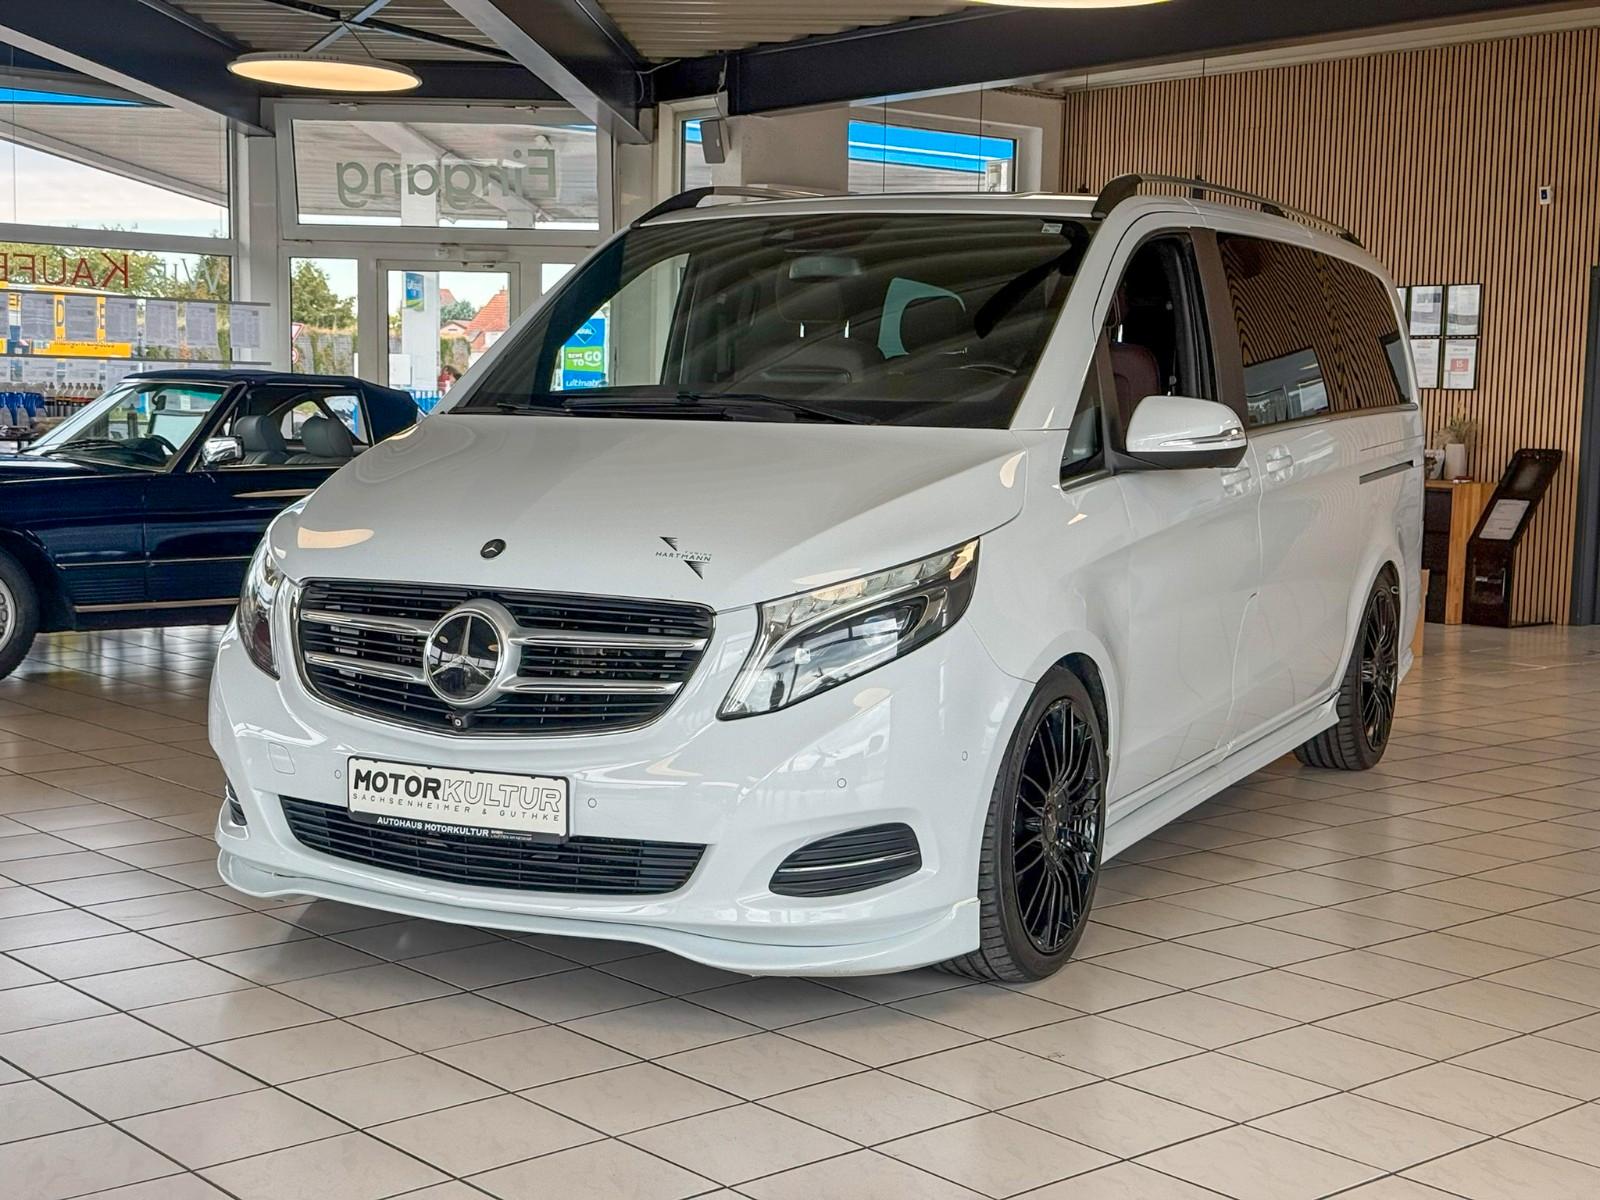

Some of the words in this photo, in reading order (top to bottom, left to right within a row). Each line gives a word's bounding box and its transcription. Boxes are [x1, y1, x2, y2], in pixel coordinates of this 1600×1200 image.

[573, 359, 584, 367] TO
[584, 351, 602, 362] GO
[655, 551, 711, 561] HARTMANN
[354, 769, 561, 812] MOTORKULTUR
[352, 792, 470, 814] SACHSENHEIMER
[481, 807, 488, 815] &
[499, 810, 560, 822] GUTHKE
[377, 816, 422, 829] AUTOHAUS
[424, 823, 489, 836] MOTORKULTUR
